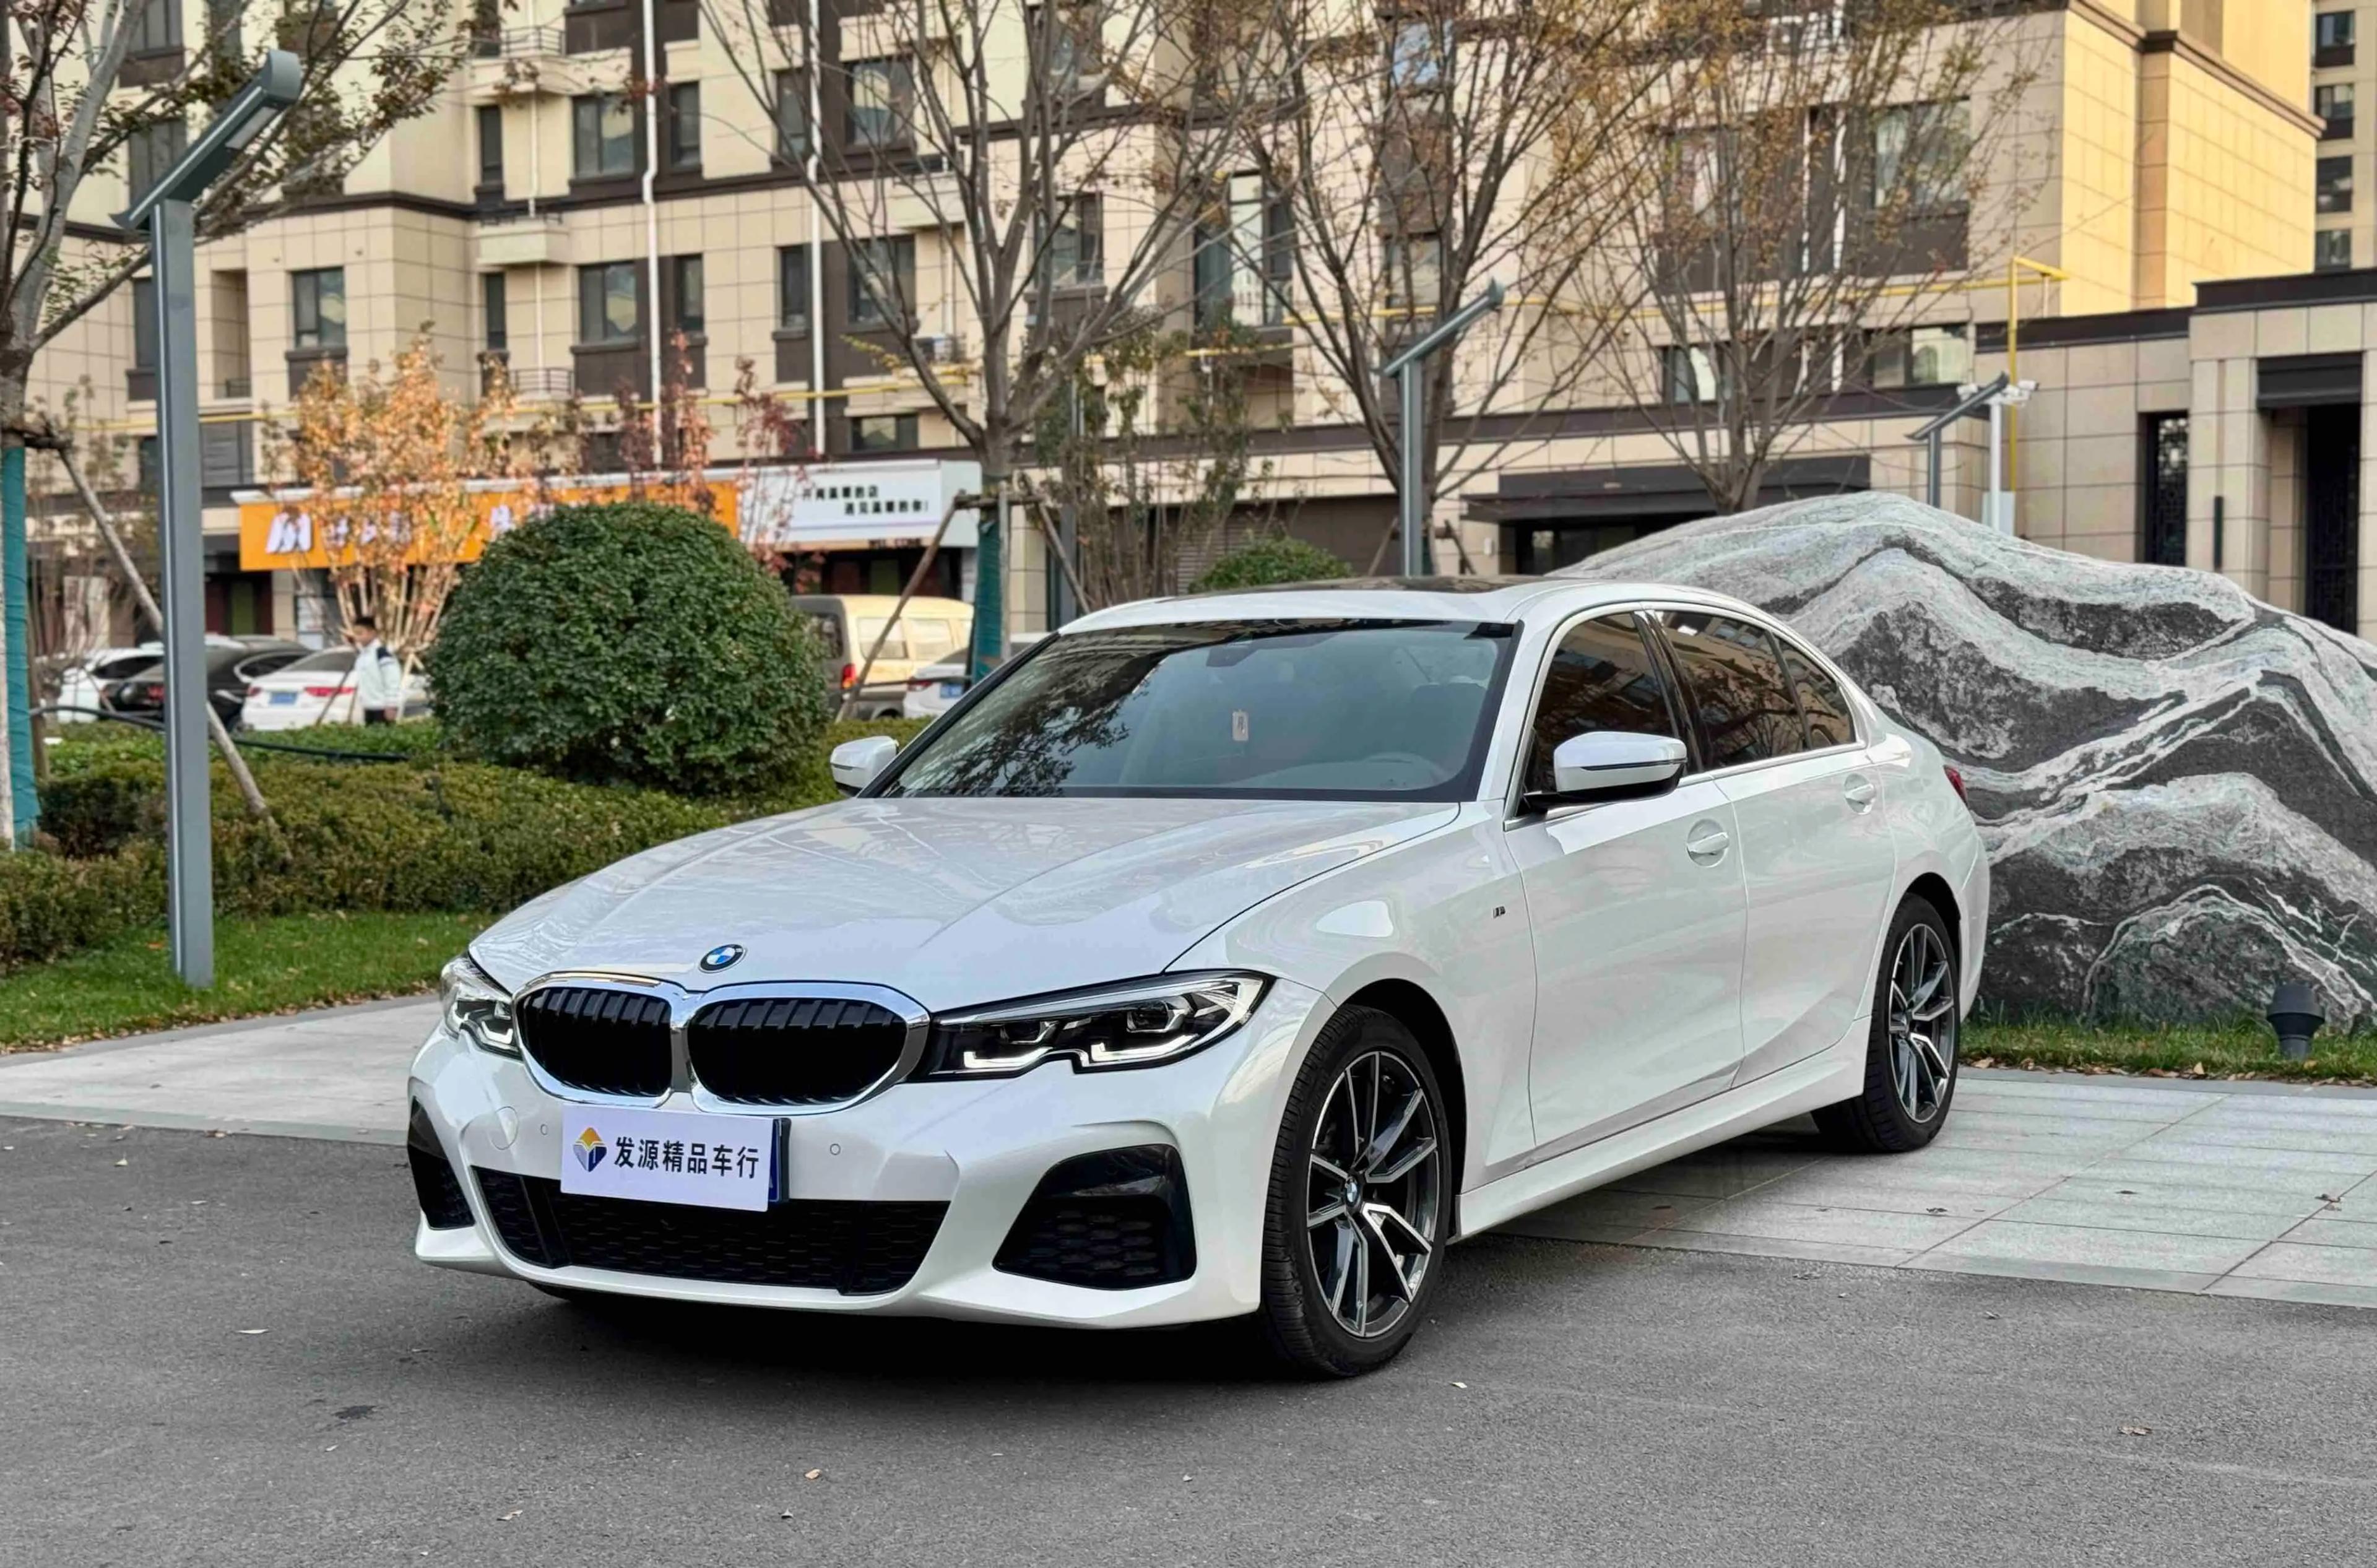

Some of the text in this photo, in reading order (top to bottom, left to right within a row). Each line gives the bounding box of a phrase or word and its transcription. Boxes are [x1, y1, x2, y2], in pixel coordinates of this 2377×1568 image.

[614, 1136, 760, 1179] 发源精品车行
